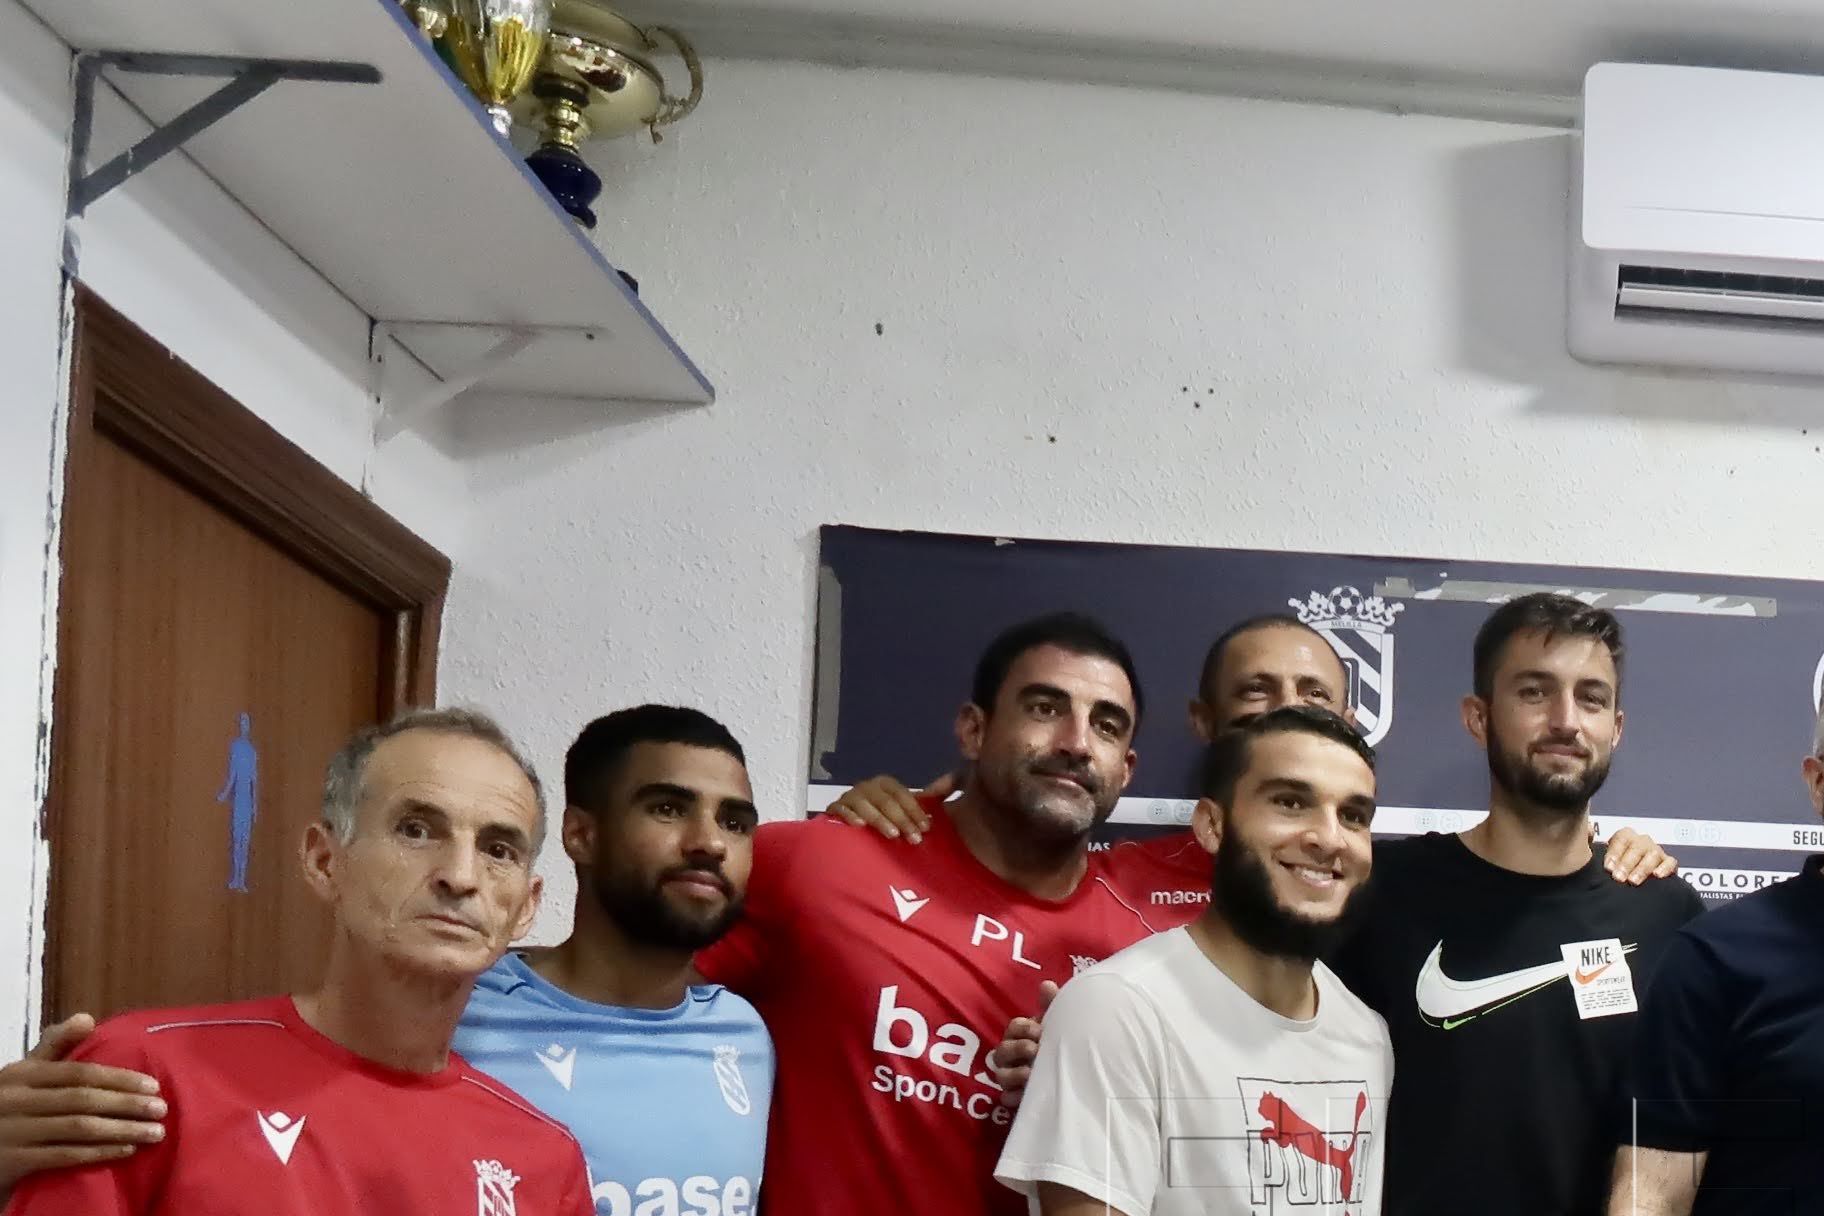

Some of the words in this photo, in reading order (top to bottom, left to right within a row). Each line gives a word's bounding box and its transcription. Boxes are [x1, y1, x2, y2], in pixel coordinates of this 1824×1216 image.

[1150, 889, 1212, 905] macr
[970, 913, 1042, 970] PL
[1580, 946, 1612, 967] NIKE
